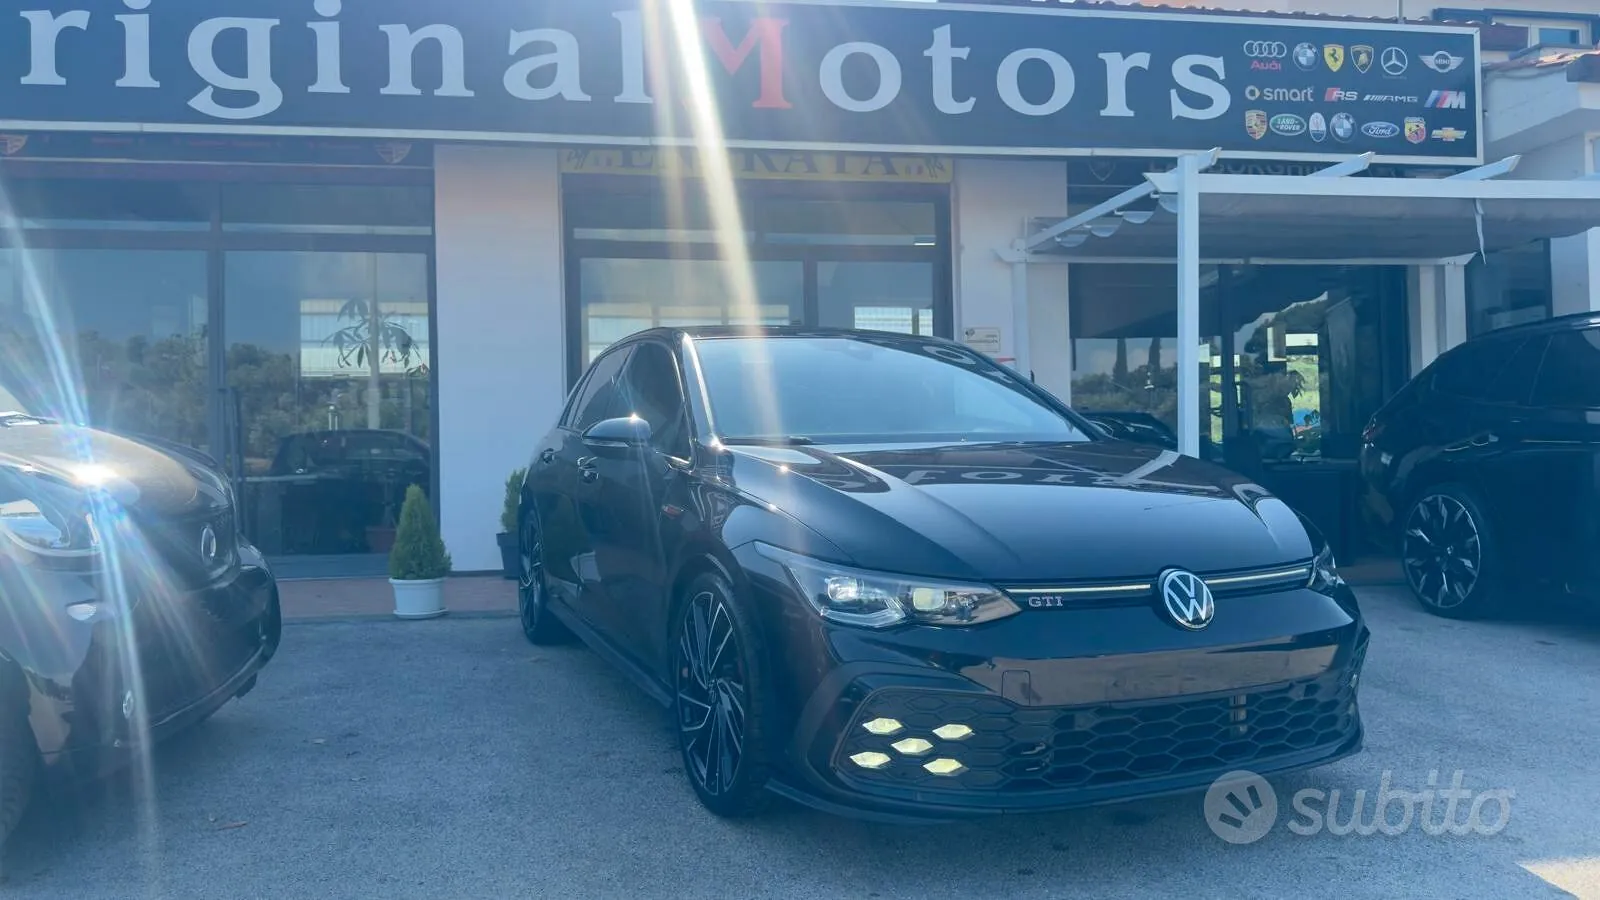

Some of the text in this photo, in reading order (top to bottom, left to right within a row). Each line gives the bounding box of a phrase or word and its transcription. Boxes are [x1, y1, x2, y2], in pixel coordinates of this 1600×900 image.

[1250, 60, 1281, 71] Audi
[1263, 86, 1314, 102] smart
[1331, 91, 1358, 101] RS
[1368, 125, 1393, 135] Ford
[1028, 596, 1063, 607] GTI
